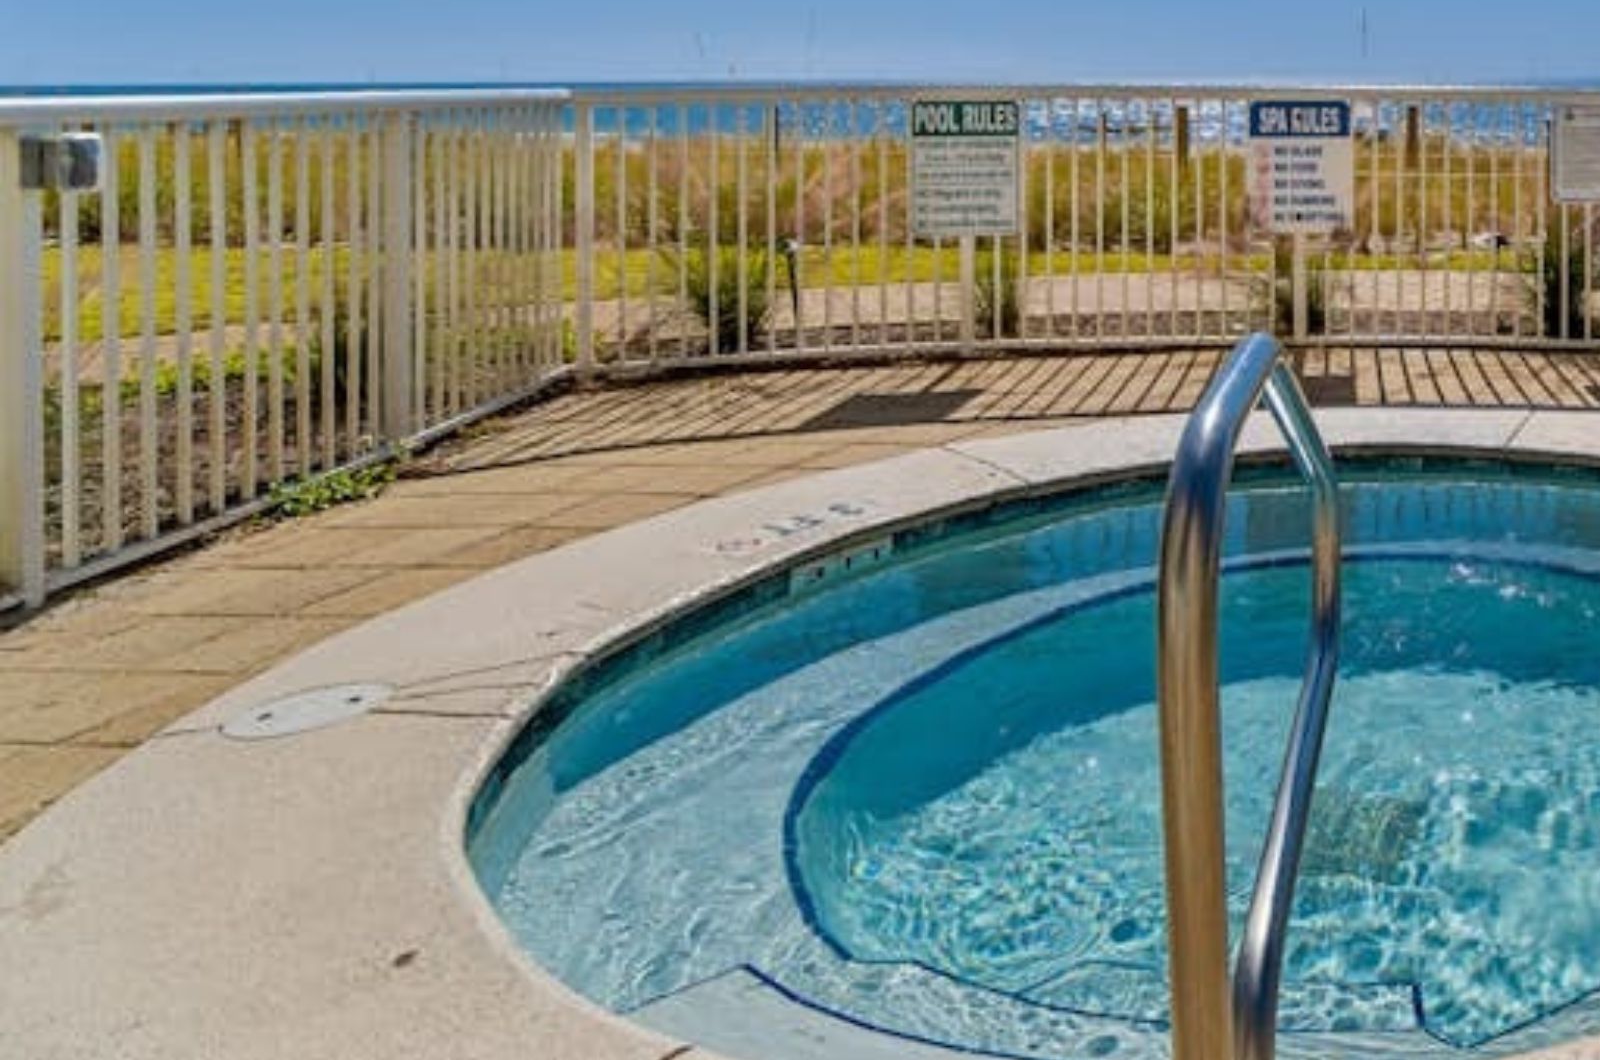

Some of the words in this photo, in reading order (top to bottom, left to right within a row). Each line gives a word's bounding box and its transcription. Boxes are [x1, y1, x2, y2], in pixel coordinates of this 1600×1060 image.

[914, 104, 960, 133] POOL
[961, 104, 1017, 133] RULES
[1259, 106, 1288, 134] SPA
